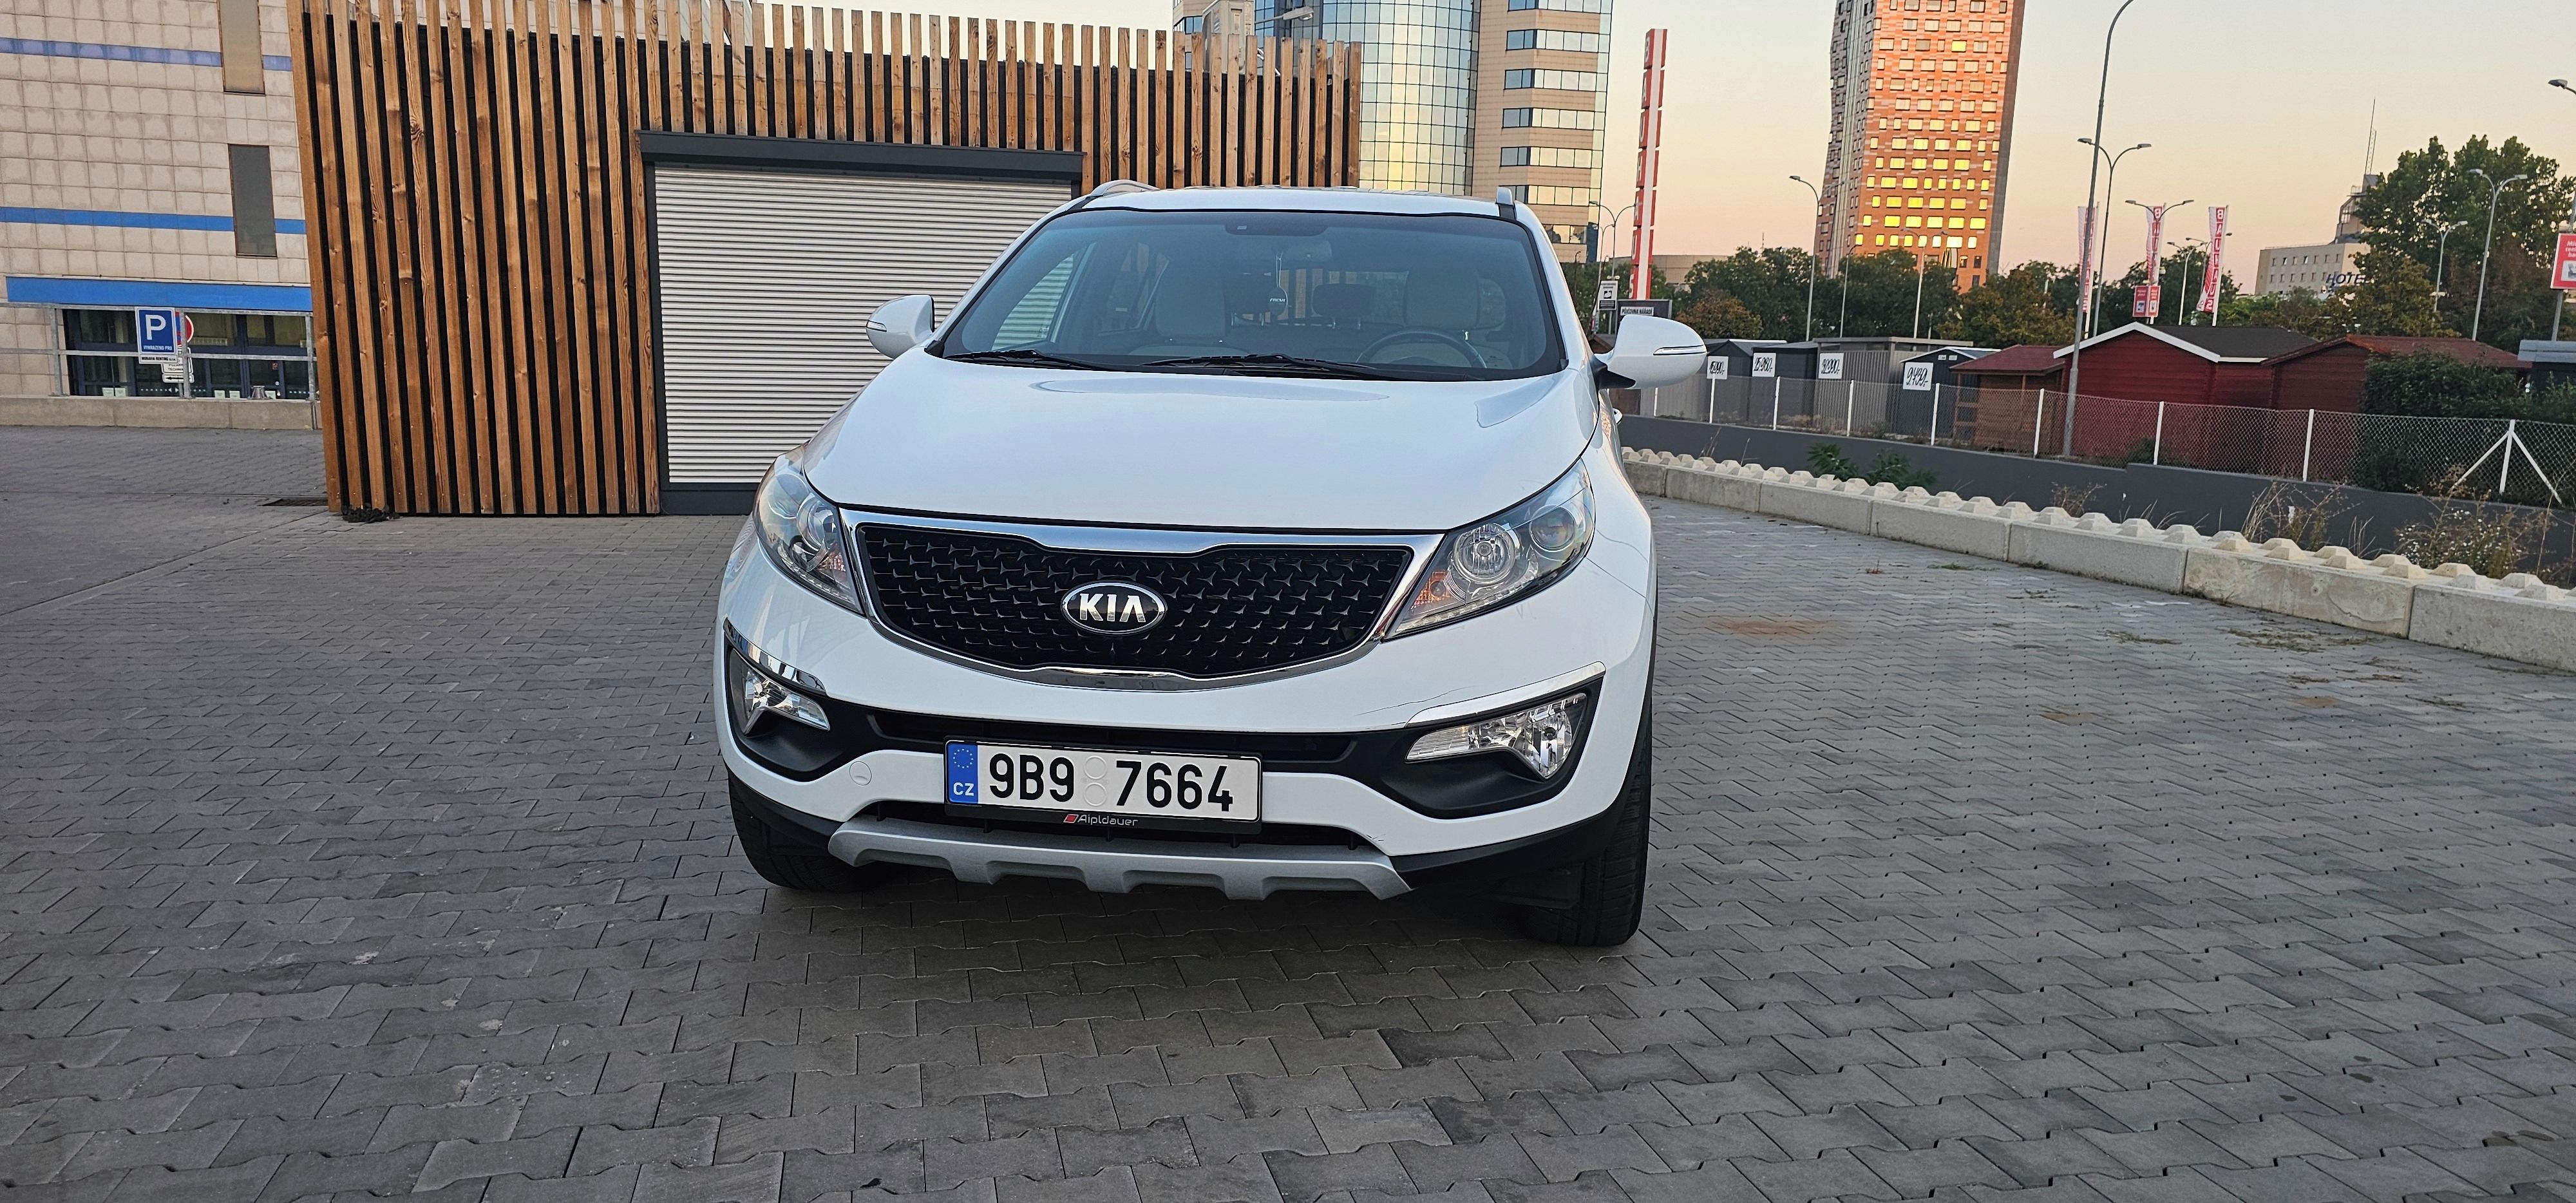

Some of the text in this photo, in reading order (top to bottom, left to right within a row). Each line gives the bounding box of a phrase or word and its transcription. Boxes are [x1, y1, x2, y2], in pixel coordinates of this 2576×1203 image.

[145, 314, 166, 341] P
[1079, 593, 1146, 623] KIA
[953, 753, 1233, 812] CZ 9B9 7664
